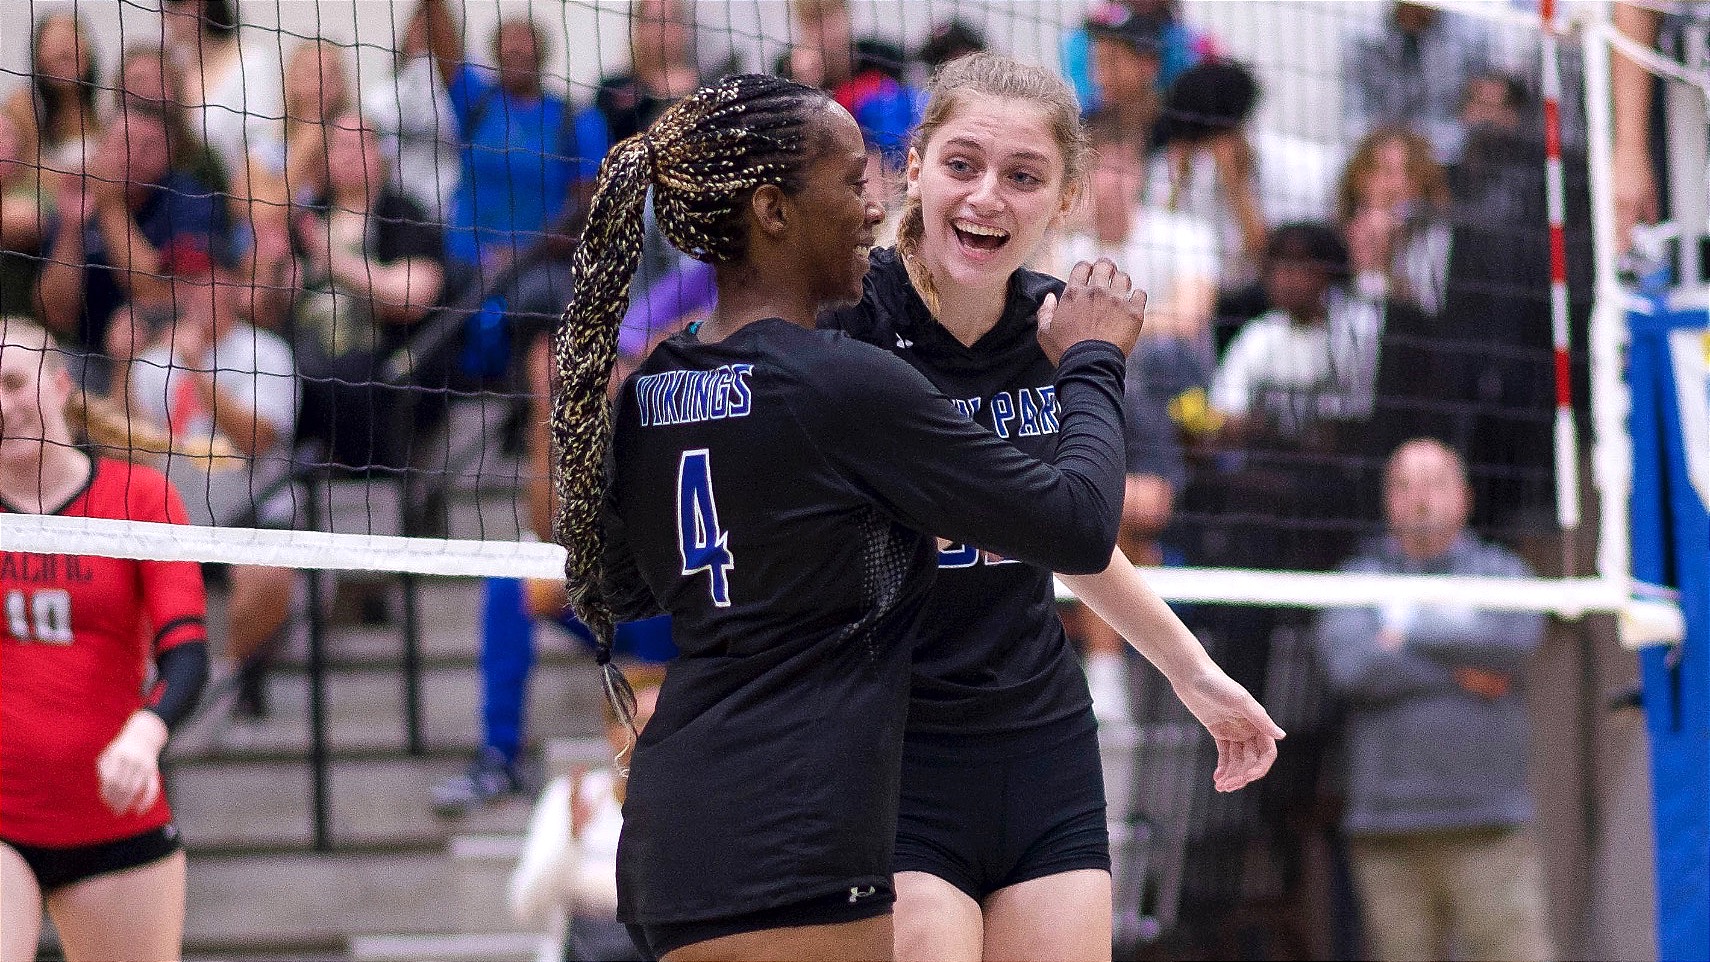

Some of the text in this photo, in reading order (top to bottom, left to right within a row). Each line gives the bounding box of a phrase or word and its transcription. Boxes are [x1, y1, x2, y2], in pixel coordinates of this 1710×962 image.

[636, 363, 754, 426] VIKINGS
[677, 448, 734, 607] 4
[5, 589, 74, 644] 10
